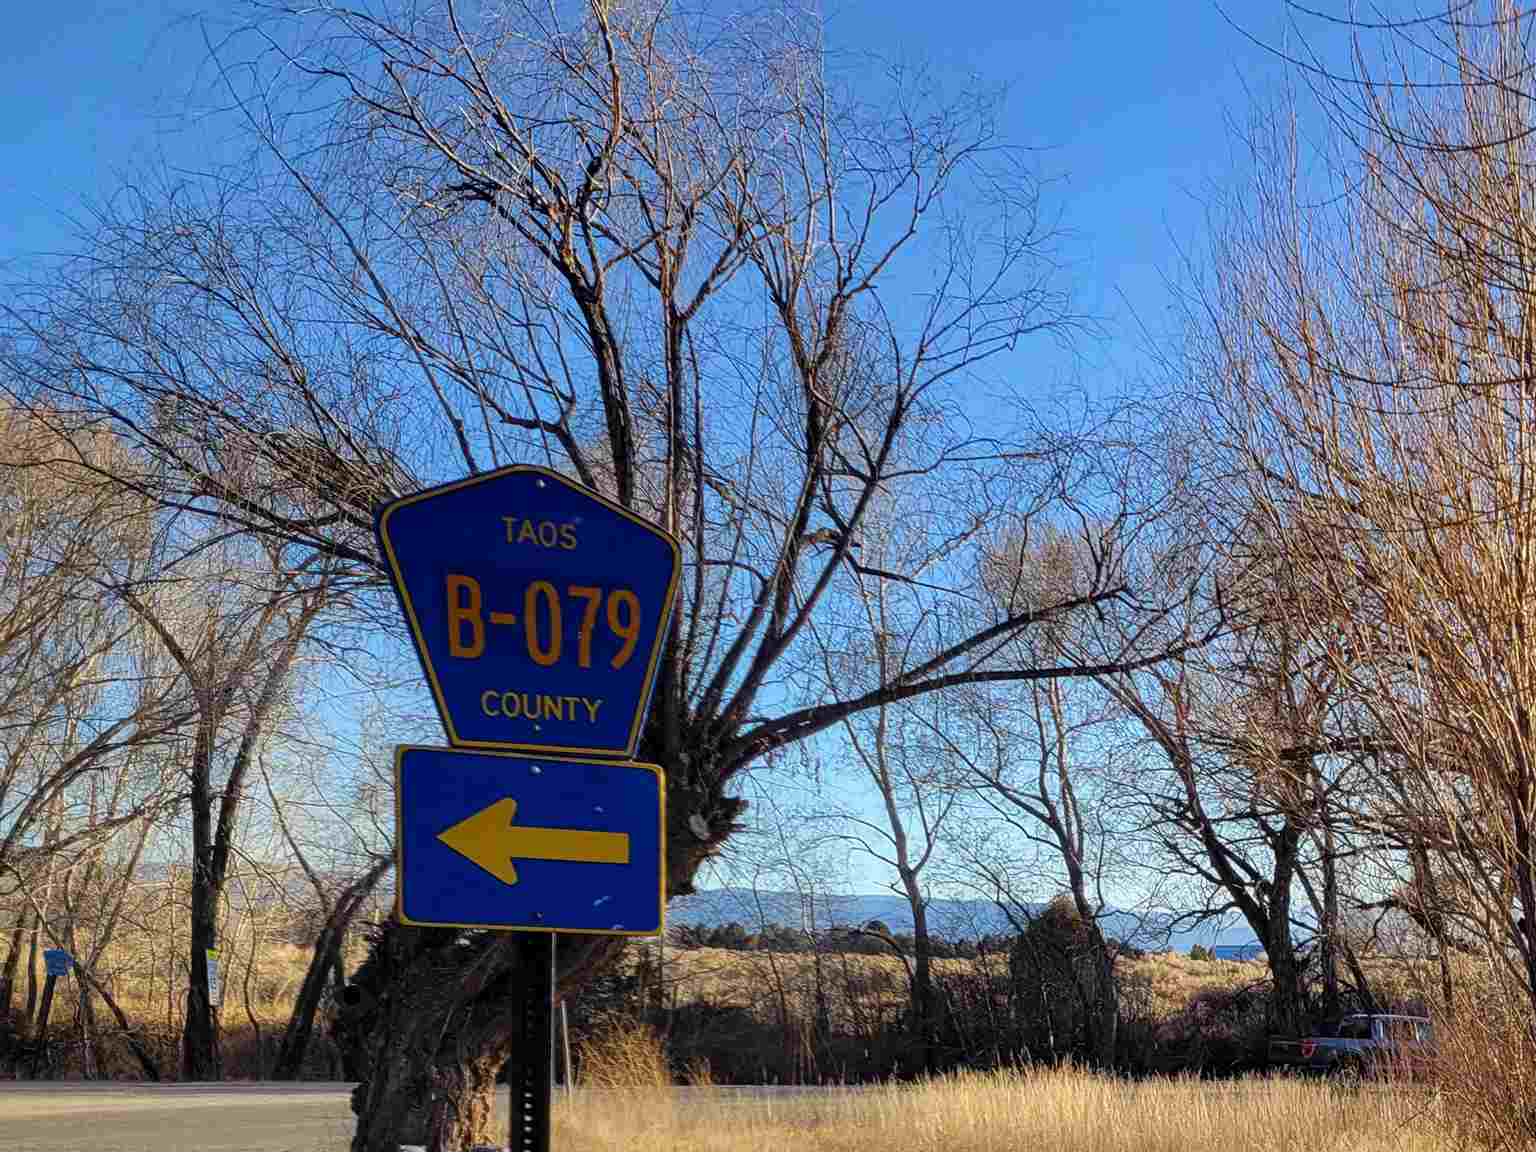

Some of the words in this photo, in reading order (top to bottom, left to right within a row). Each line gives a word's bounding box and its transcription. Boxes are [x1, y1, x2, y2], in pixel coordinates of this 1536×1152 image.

[502, 516, 578, 550] TAOS
[446, 573, 642, 670] B-079
[480, 690, 603, 722] COUNTY
